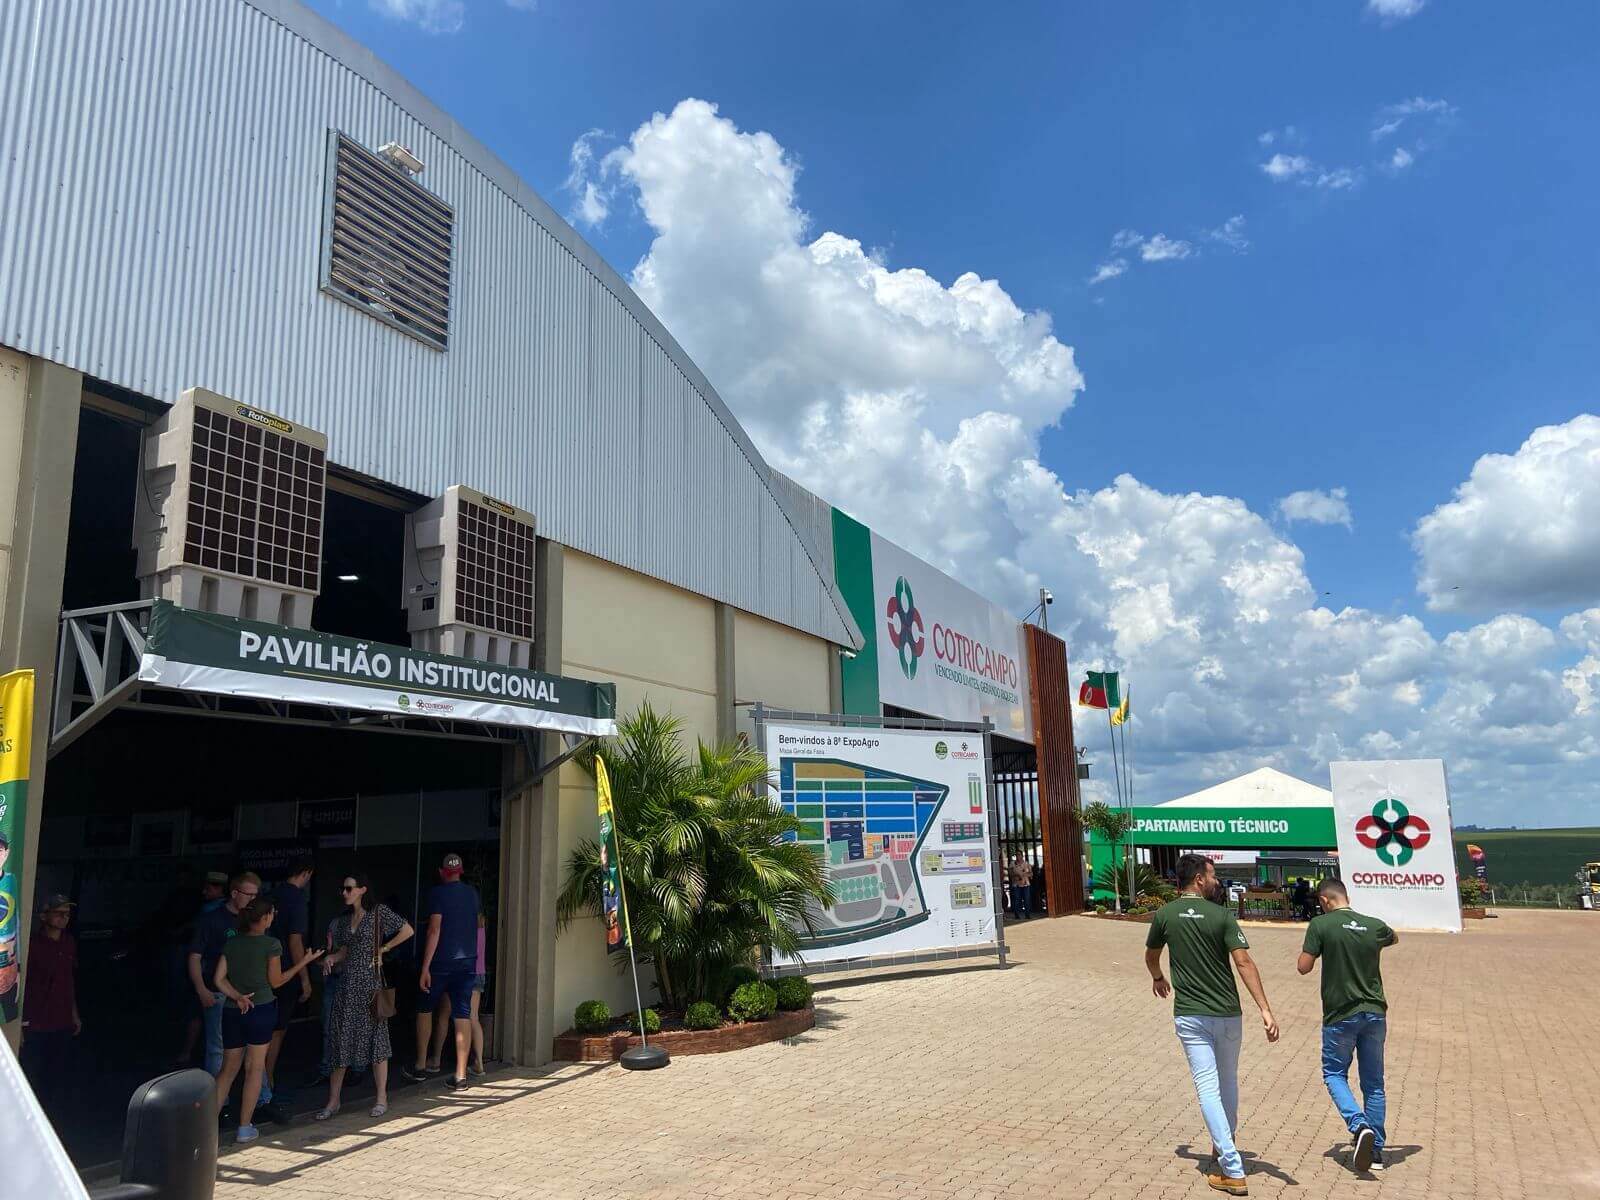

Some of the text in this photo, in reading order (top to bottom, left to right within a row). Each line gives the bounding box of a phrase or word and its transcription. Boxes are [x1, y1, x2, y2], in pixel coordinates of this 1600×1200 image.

[248, 411, 290, 432] Rotoplast
[239, 630, 560, 703] PAVILHÃO INSTITUCIONAL
[933, 623, 1017, 689] COTRICAMPO
[934, 663, 963, 684] VENCENDO
[778, 734, 825, 745] Bem-vindos
[827, 737, 832, 745] à
[843, 737, 880, 748] ExpoAgro
[1129, 816, 1289, 833] PARTAMENTO TÉCNICO
[1352, 872, 1445, 886] COTRICAMPO
